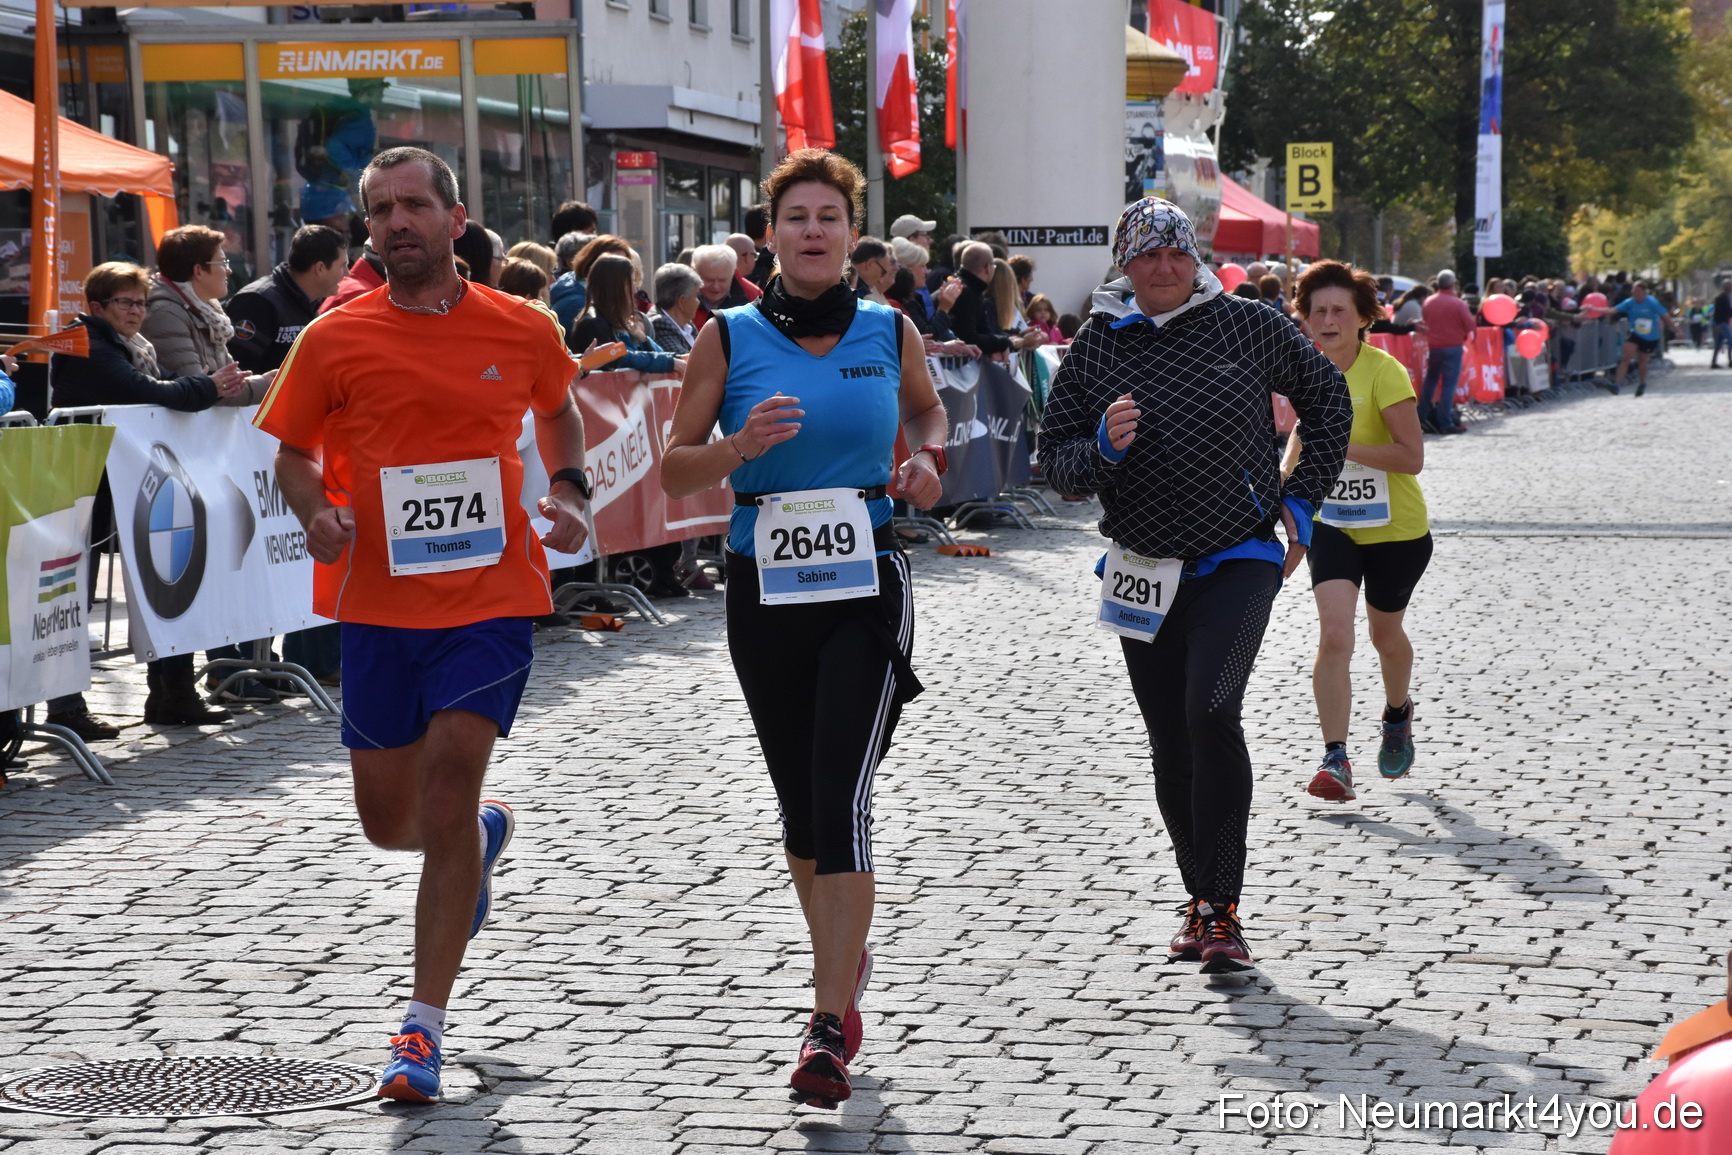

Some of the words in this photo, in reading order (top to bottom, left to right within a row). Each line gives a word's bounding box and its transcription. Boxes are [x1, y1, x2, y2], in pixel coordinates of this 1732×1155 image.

[277, 49, 444, 72] RUNMARKT.DE
[1292, 146, 1327, 159] Block
[1298, 165, 1321, 197] B
[1602, 239, 1615, 258] C
[621, 420, 648, 479] NEUE
[426, 471, 467, 484] BOCK
[402, 491, 487, 531] 2574
[794, 499, 836, 512] BOCK
[1337, 507, 1367, 516] Gerlinde
[264, 531, 308, 565] WENIGER
[425, 539, 471, 554] Thomas
[770, 522, 856, 561] 2649
[1129, 555, 1158, 568] BOCK
[798, 570, 837, 584] Sabine
[1113, 571, 1161, 608] 2291
[1119, 610, 1151, 626] Andreas
